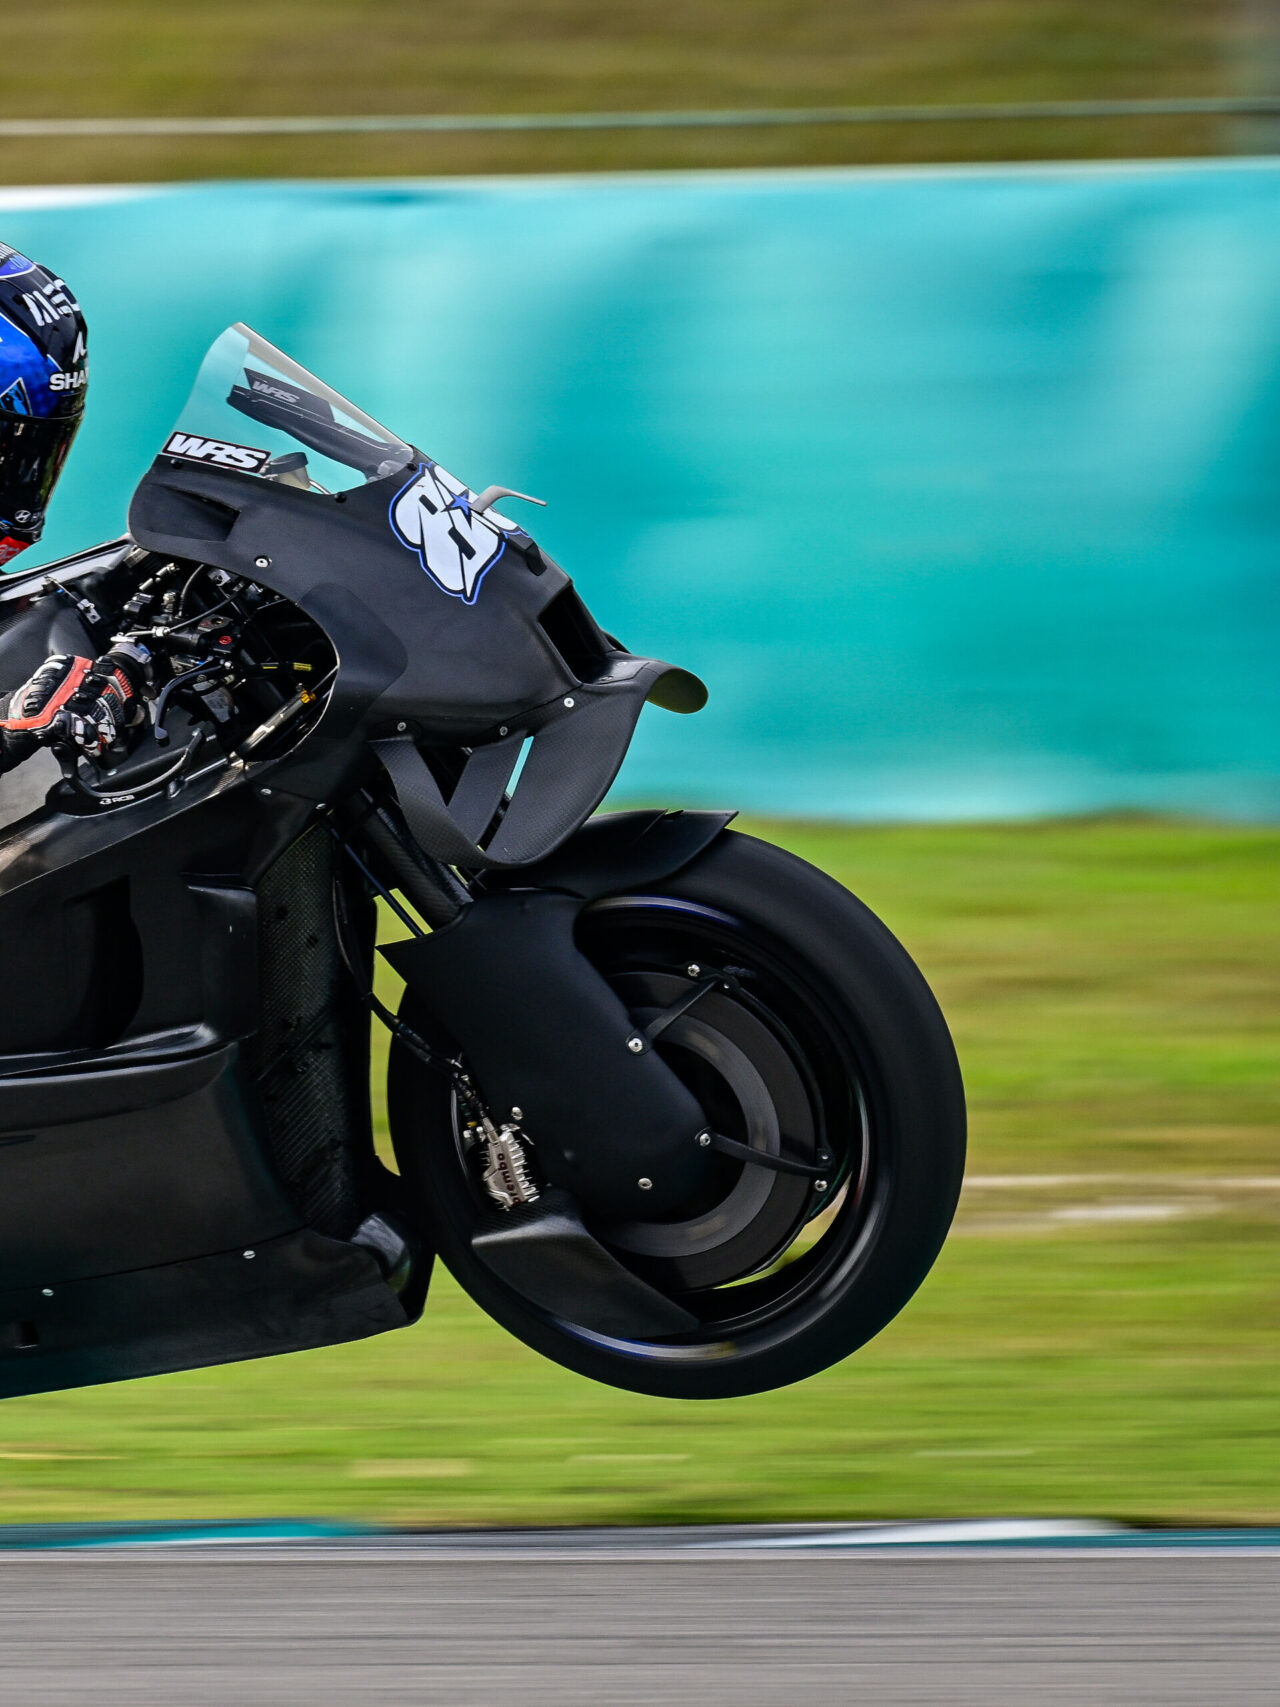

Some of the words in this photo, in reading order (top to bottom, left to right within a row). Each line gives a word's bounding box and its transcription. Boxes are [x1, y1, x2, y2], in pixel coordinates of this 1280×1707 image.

[50, 368, 88, 391] SHA
[252, 380, 300, 403] WRS
[167, 433, 266, 469] WRS
[497, 1153, 521, 1207] brembo
